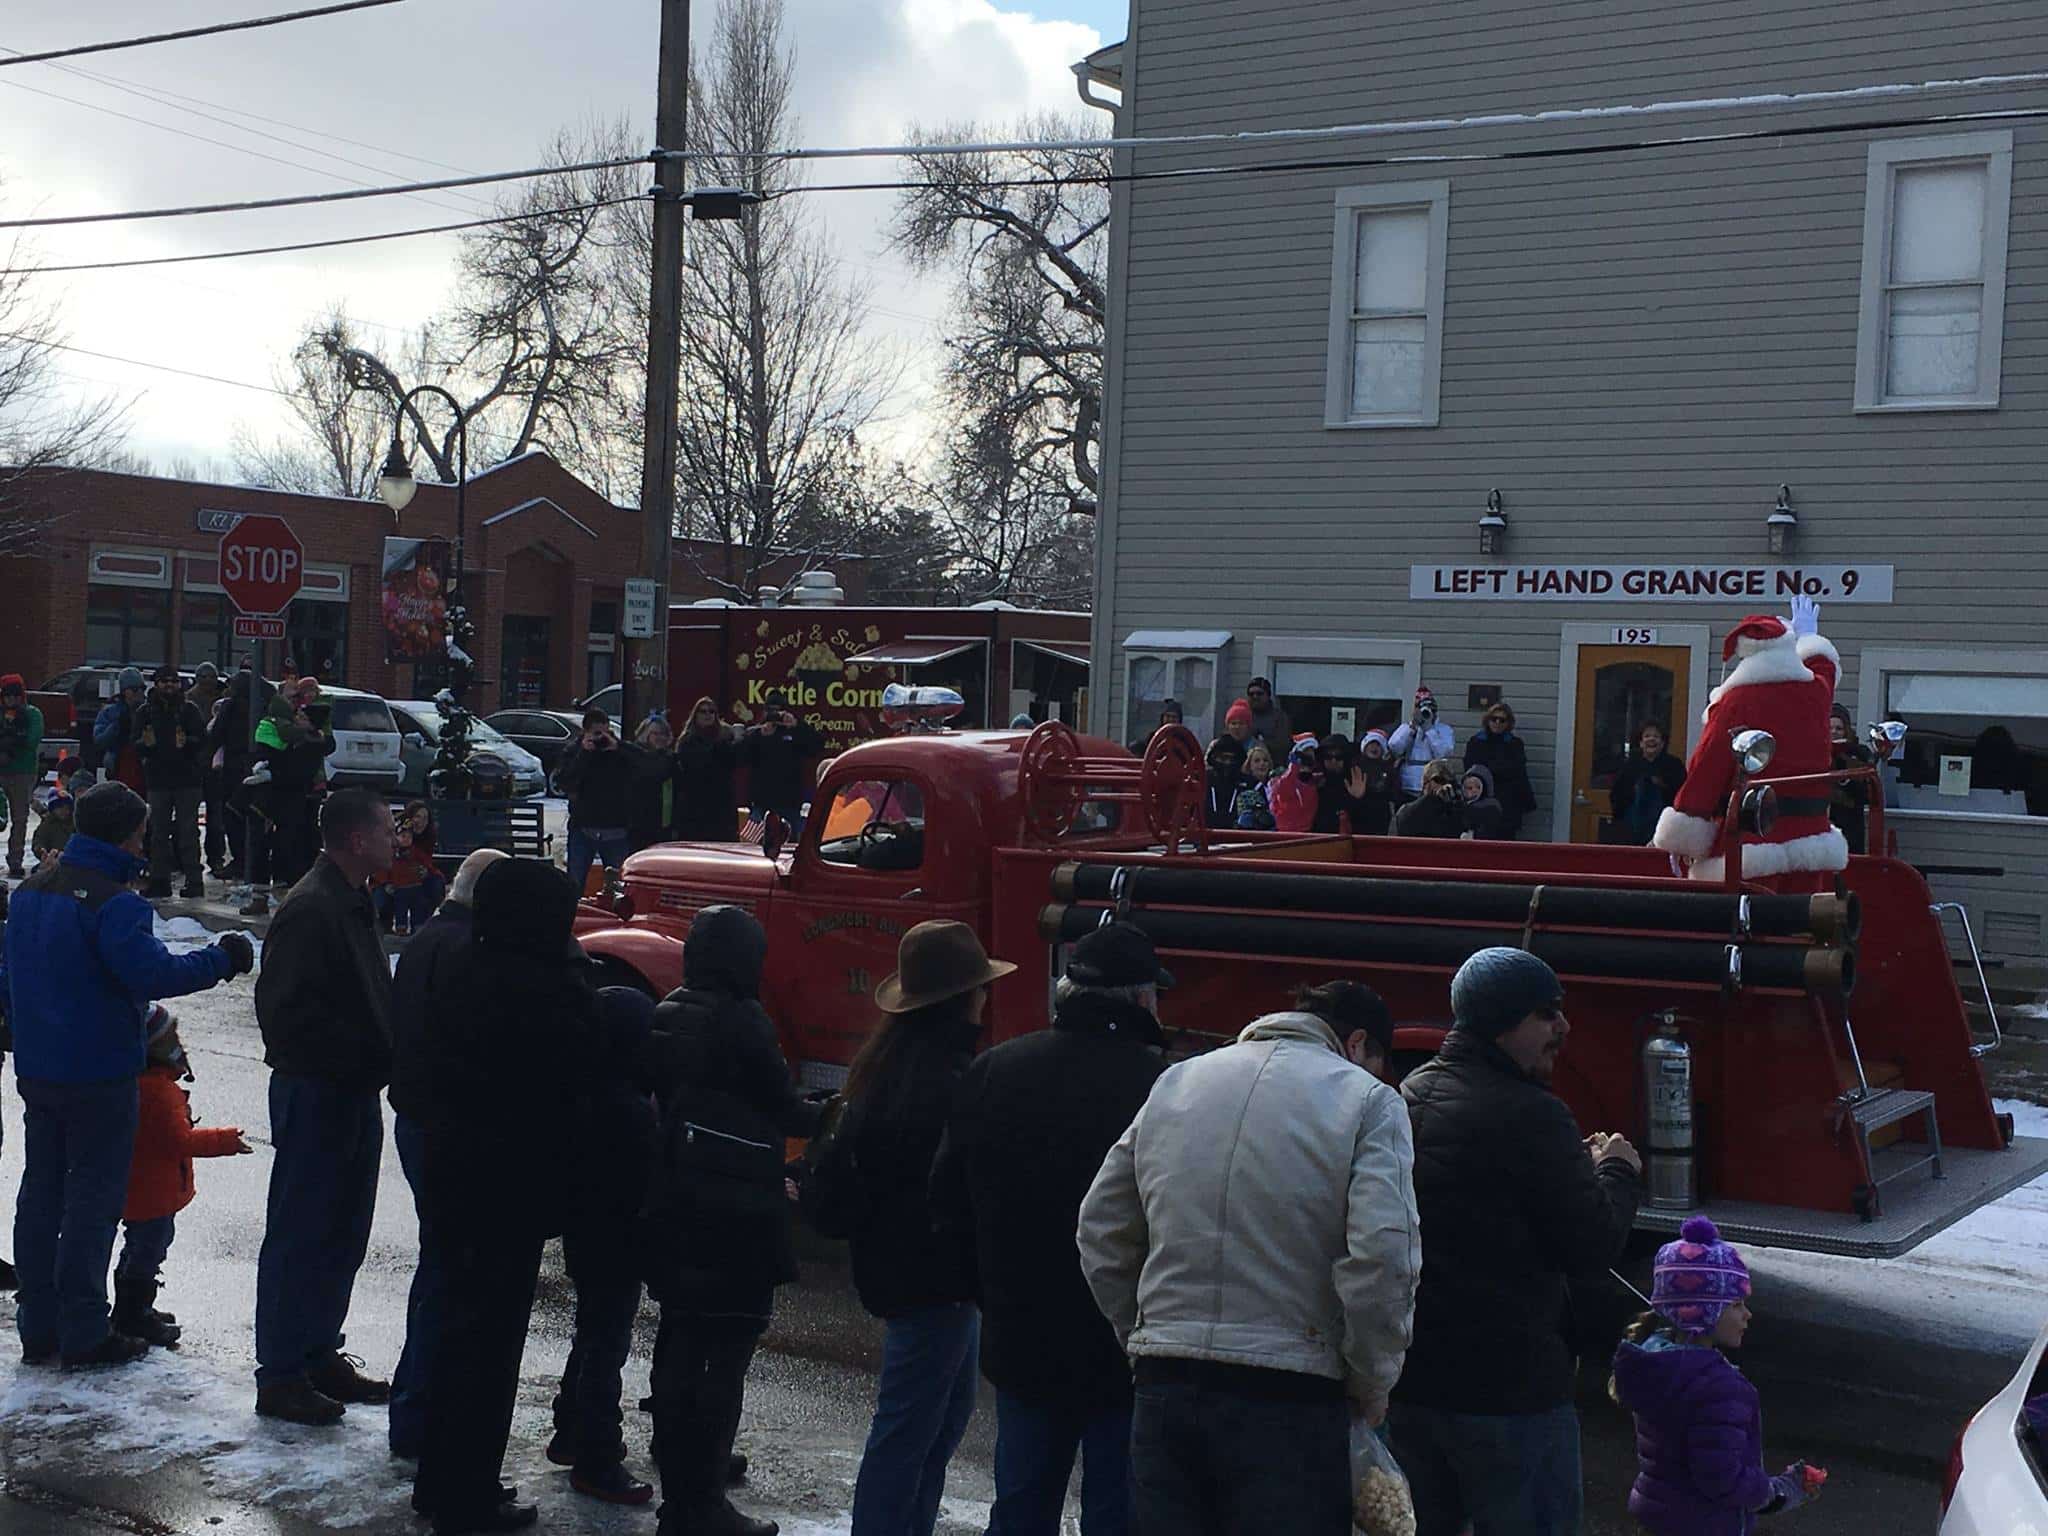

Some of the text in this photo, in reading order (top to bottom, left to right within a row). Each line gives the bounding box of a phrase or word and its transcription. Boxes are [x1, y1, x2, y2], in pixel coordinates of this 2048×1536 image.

[225, 545, 298, 584] STOP
[1434, 569, 1859, 595] LEFT HAND GRANGE No. 9
[238, 623, 281, 635] ALL WAY
[809, 624, 823, 641] &
[1617, 629, 1650, 643] 195
[825, 681, 883, 707] Corn
